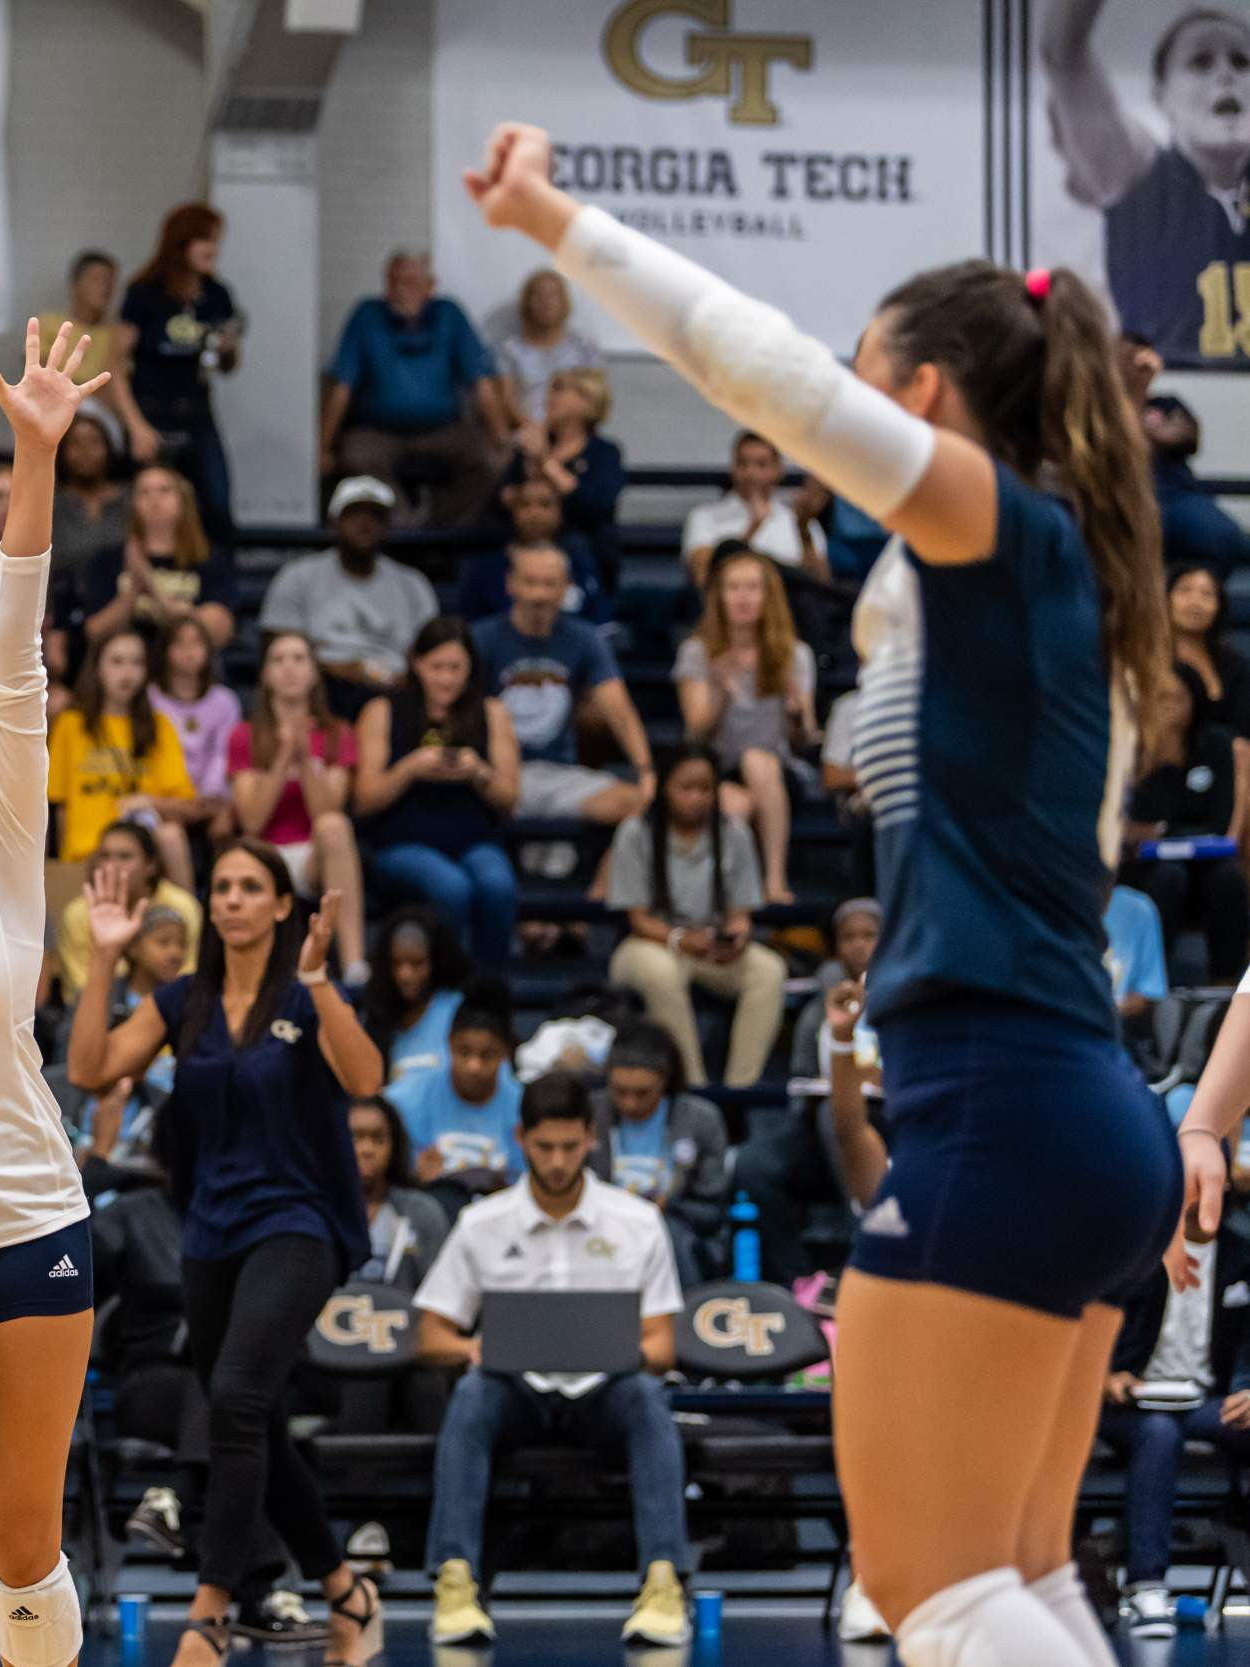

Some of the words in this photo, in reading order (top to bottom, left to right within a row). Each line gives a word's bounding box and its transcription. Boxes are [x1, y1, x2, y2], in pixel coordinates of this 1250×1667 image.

[601, 0, 815, 125] GT
[549, 144, 738, 198] EORGIA
[761, 150, 915, 202] TECH
[315, 1294, 409, 1354] GT
[692, 1296, 786, 1356] GT
